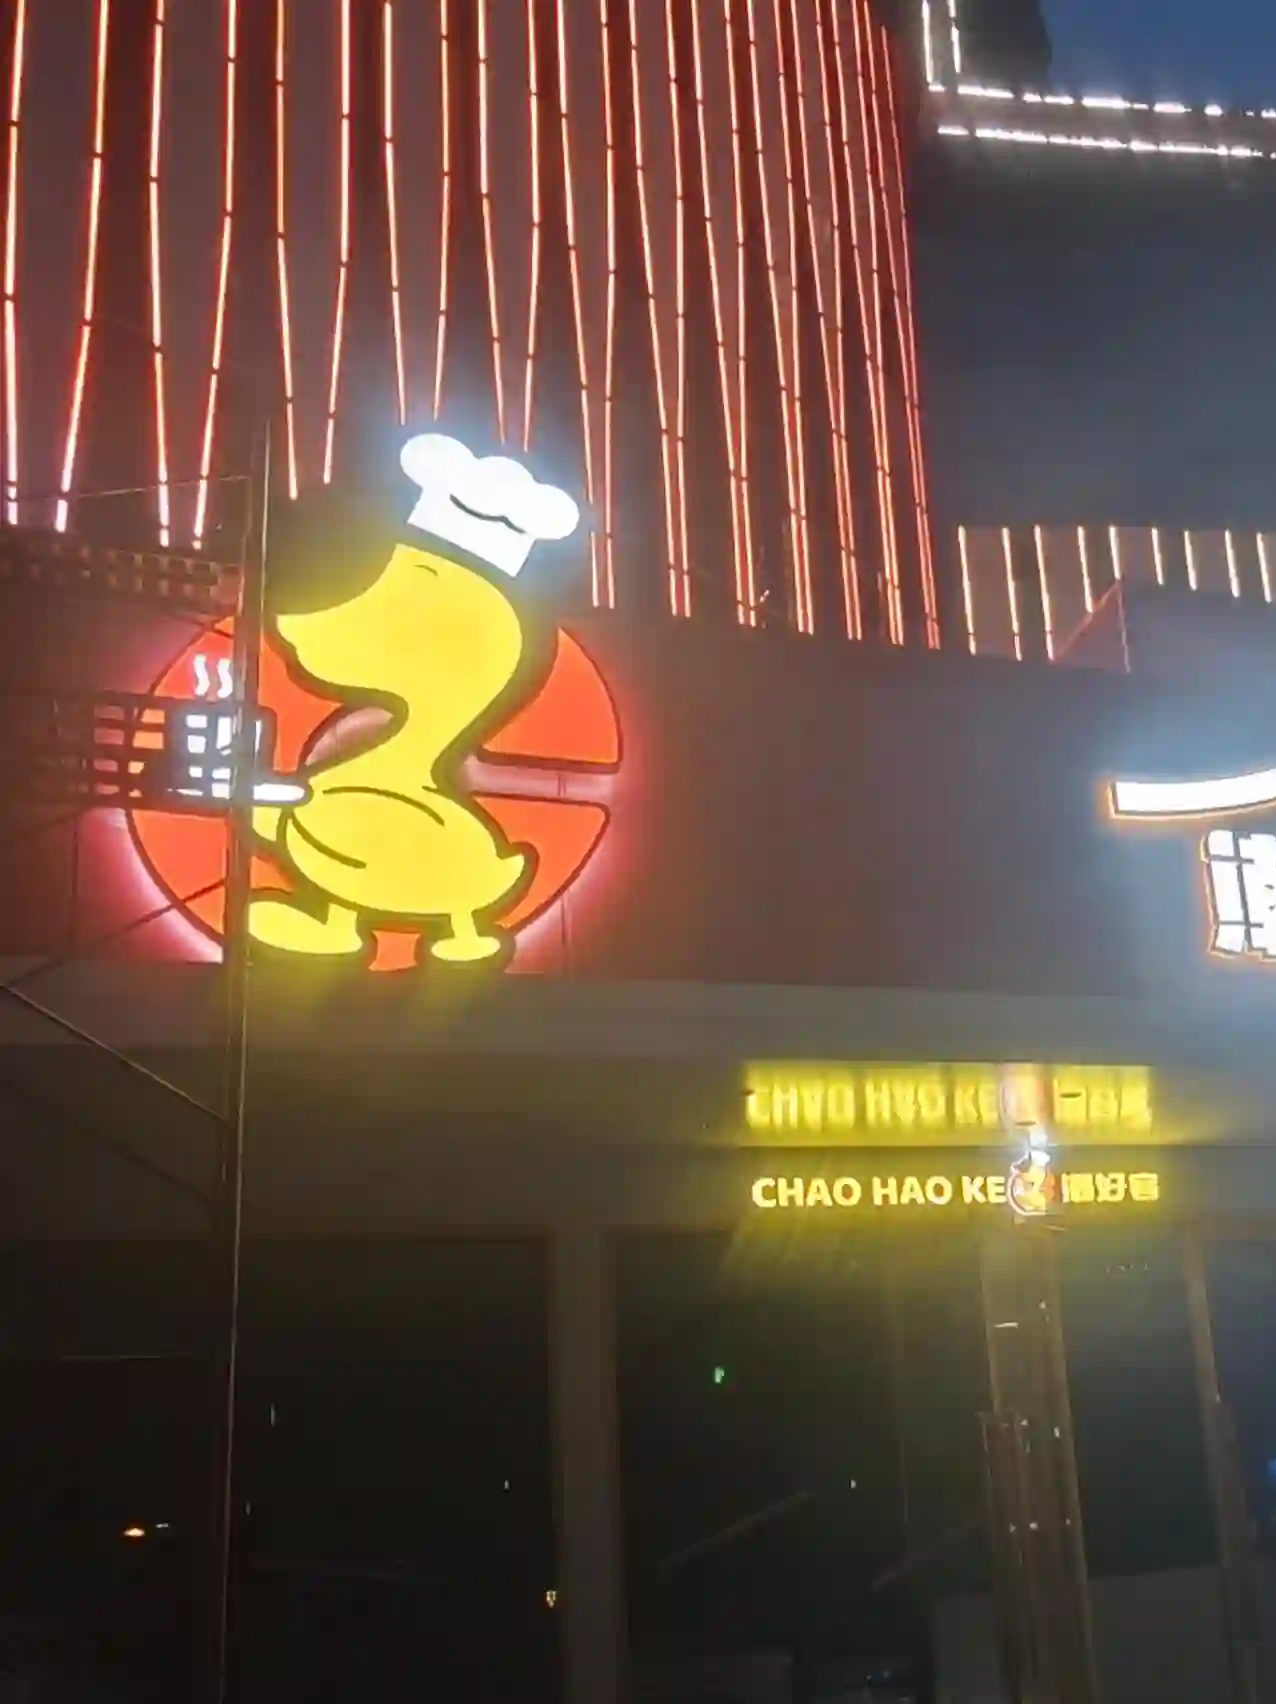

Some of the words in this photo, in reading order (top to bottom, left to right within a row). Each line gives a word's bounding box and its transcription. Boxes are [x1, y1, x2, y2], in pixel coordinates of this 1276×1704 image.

[752, 1175, 862, 1208] CHAO
[872, 1175, 952, 1206] HAO
[962, 1174, 1007, 1205] KE
